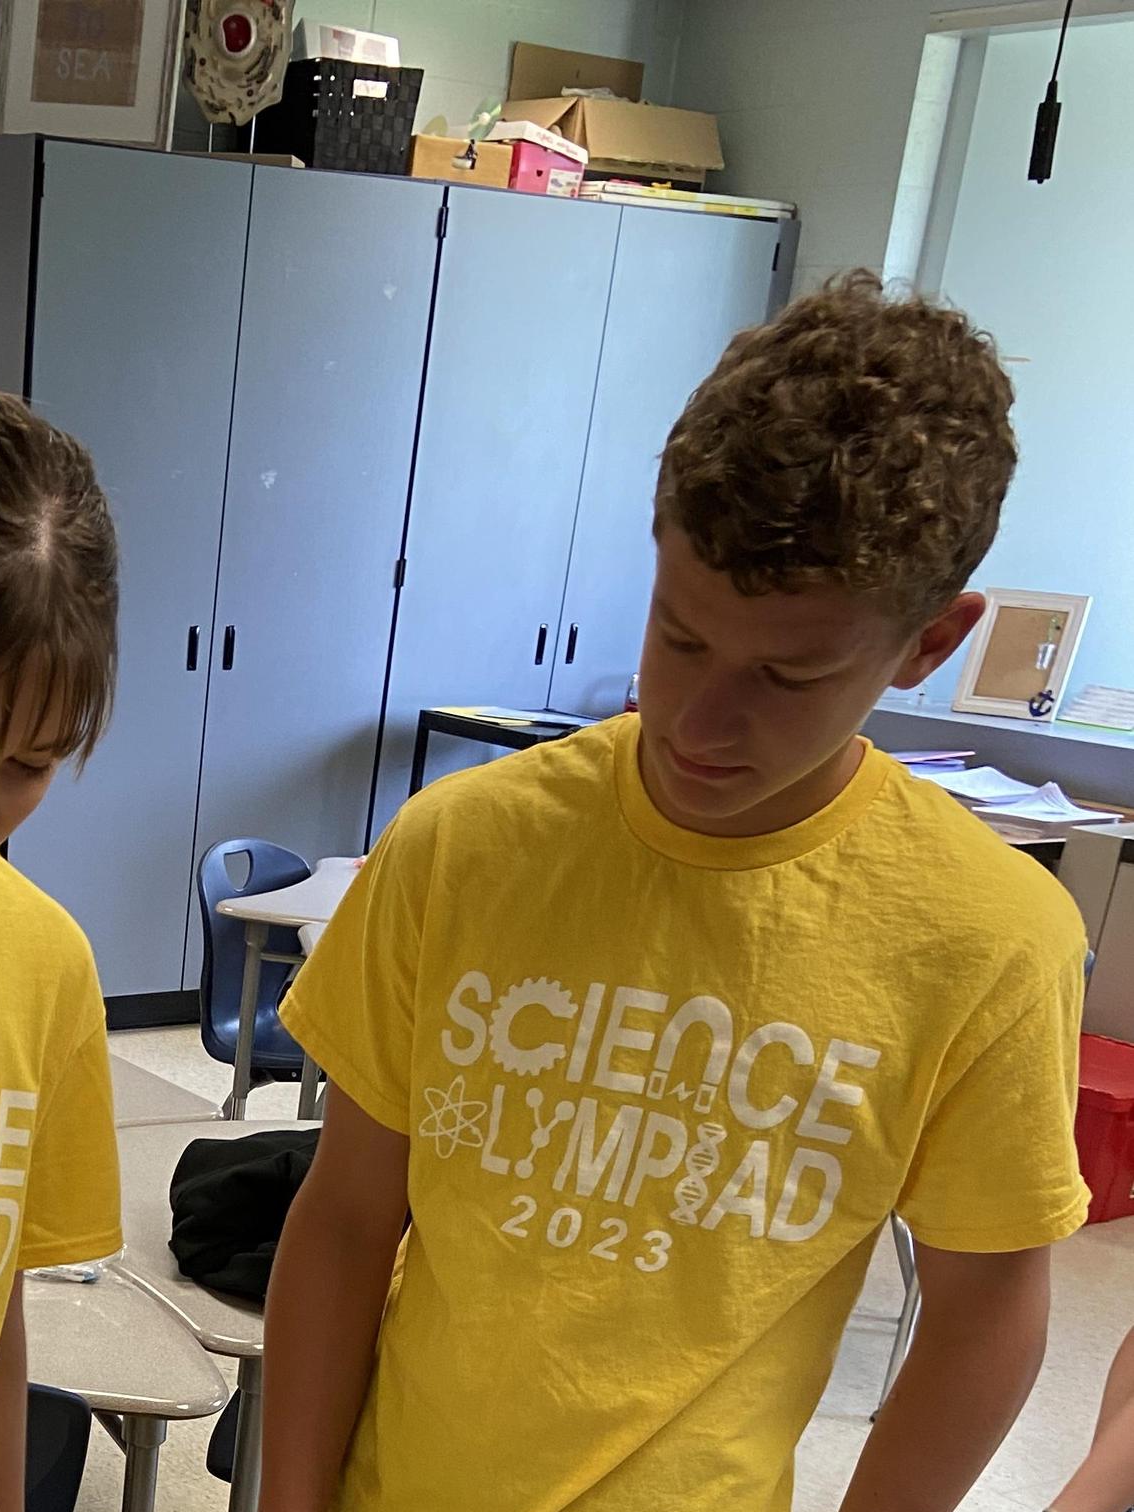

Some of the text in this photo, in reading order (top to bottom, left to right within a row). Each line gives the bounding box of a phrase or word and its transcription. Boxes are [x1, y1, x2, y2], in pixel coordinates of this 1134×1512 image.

[56, 46, 111, 81] SEA
[441, 970, 882, 1145] SCIENCE
[500, 1194, 673, 1273] 2023
